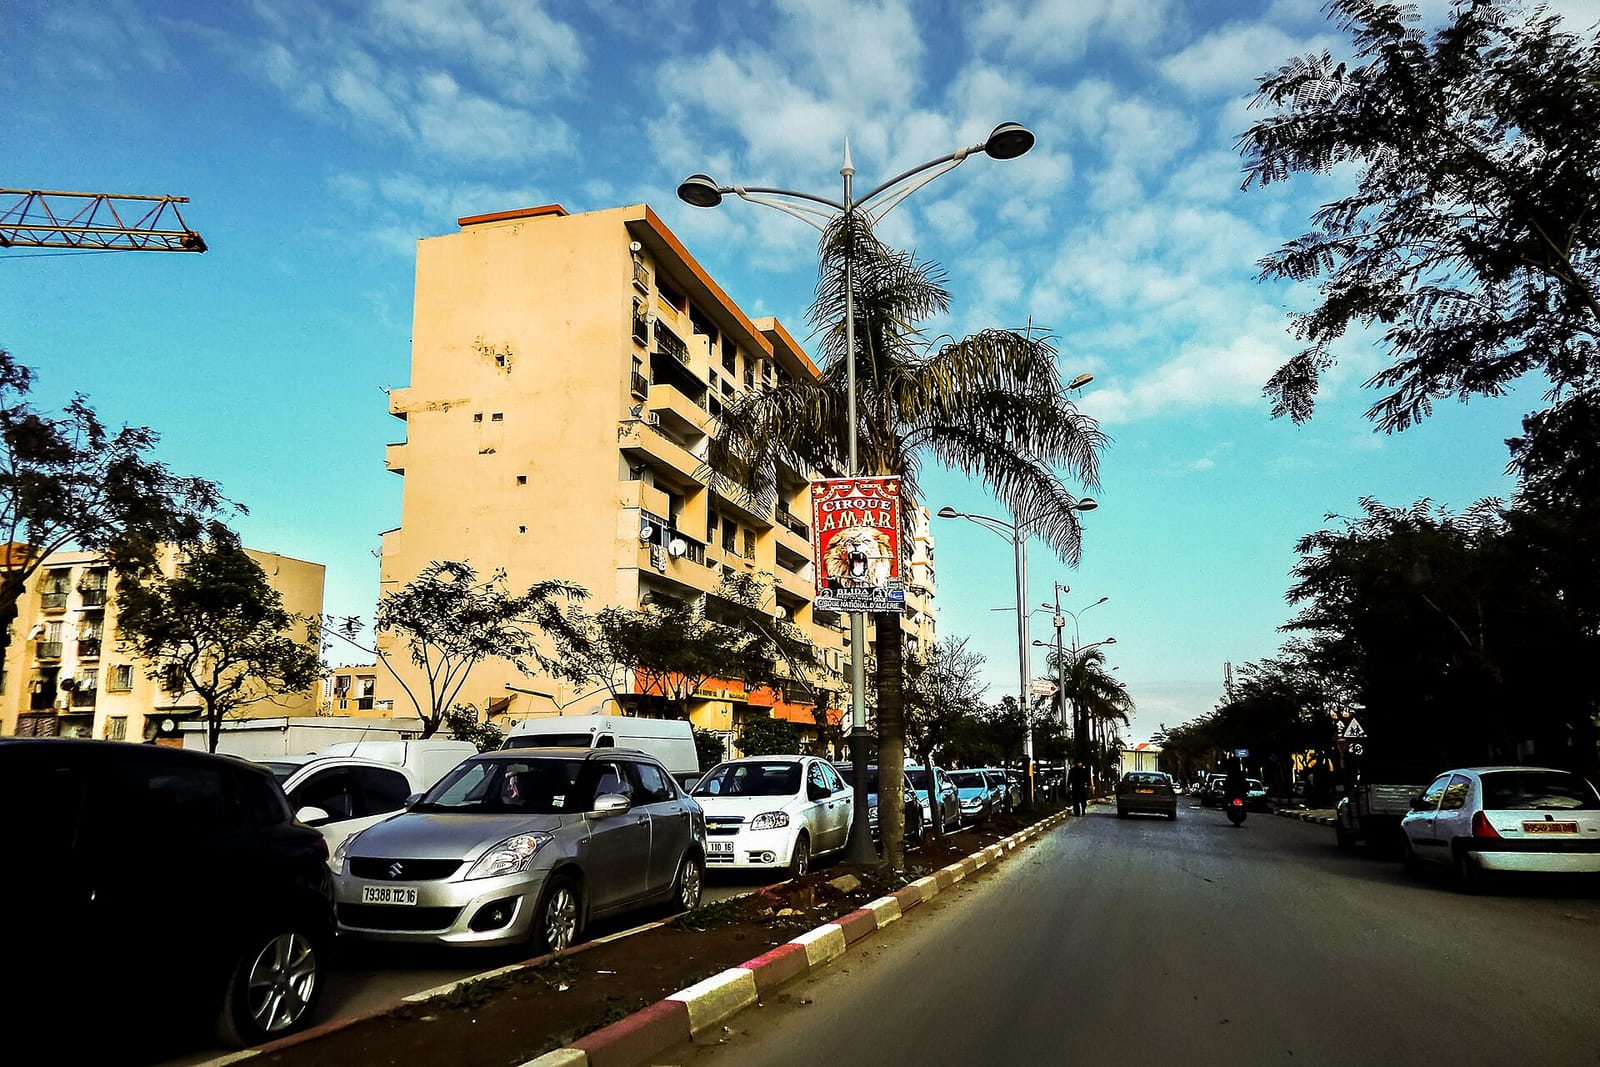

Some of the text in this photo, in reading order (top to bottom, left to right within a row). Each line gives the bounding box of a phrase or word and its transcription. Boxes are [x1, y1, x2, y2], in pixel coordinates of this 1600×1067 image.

[822, 498, 891, 512] CIRQUE
[819, 509, 895, 533] AMAR
[837, 588, 869, 596] BLIDA
[840, 600, 869, 609] NATIONAL
[364, 887, 416, 903] 79388 112 16
